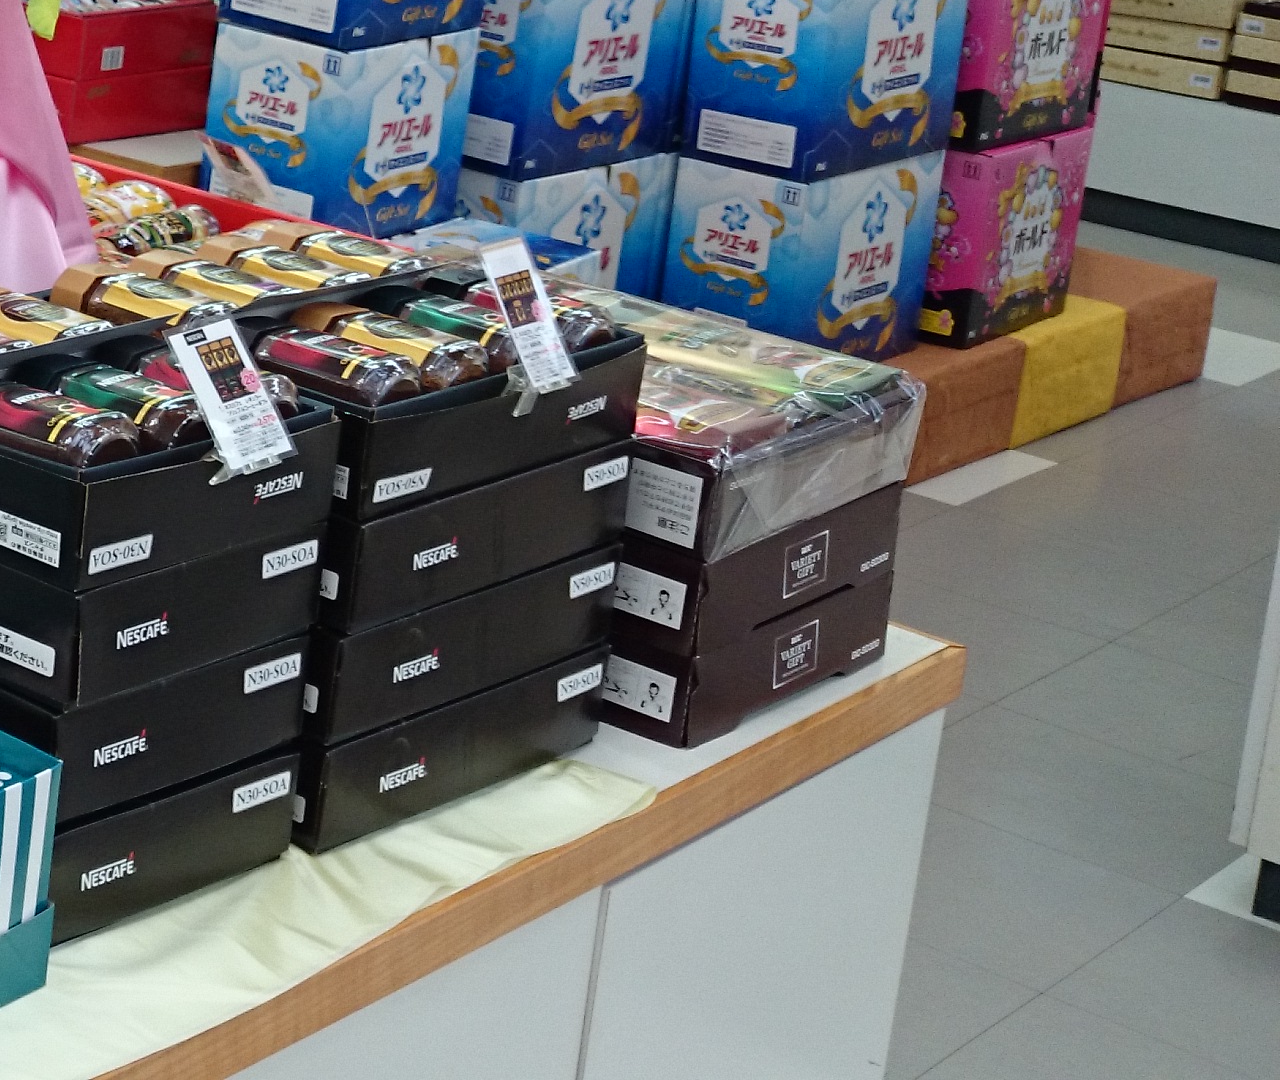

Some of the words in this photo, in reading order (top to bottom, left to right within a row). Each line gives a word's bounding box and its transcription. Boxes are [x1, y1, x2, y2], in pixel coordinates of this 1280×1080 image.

[730, 15, 787, 38] アリエール
[582, 33, 640, 67] アリエール
[873, 32, 924, 67] アリエール
[1028, 28, 1067, 60] ボールド
[246, 90, 299, 116] アリエール
[378, 113, 433, 145] アリエール
[704, 229, 760, 253] アリエール
[1013, 221, 1048, 256] ボールド
[844, 242, 894, 280] アリエール
[375, 470, 431, 500] N50-SOA
[585, 457, 628, 490] N50-SOA
[90, 540, 150, 569] N30-SOA
[264, 545, 317, 574] N30-SOA
[412, 536, 460, 572] NESCAFÉ
[790, 551, 822, 572] VARIETY
[570, 563, 614, 597] N50-SOA
[796, 564, 816, 579] GIFT
[116, 611, 170, 651] NESCAFÉ
[392, 647, 441, 684] NESCAFÉ
[780, 640, 812, 662] VARIETY
[786, 654, 806, 669] GIFT
[246, 659, 300, 689] N30-SOA
[558, 663, 602, 699] N50-SOA
[94, 729, 148, 768] NESCAFÉ
[379, 756, 428, 794] NESCAFÉ
[234, 778, 290, 808] N30-SOA
[81, 851, 137, 892] NESCAFÉ
